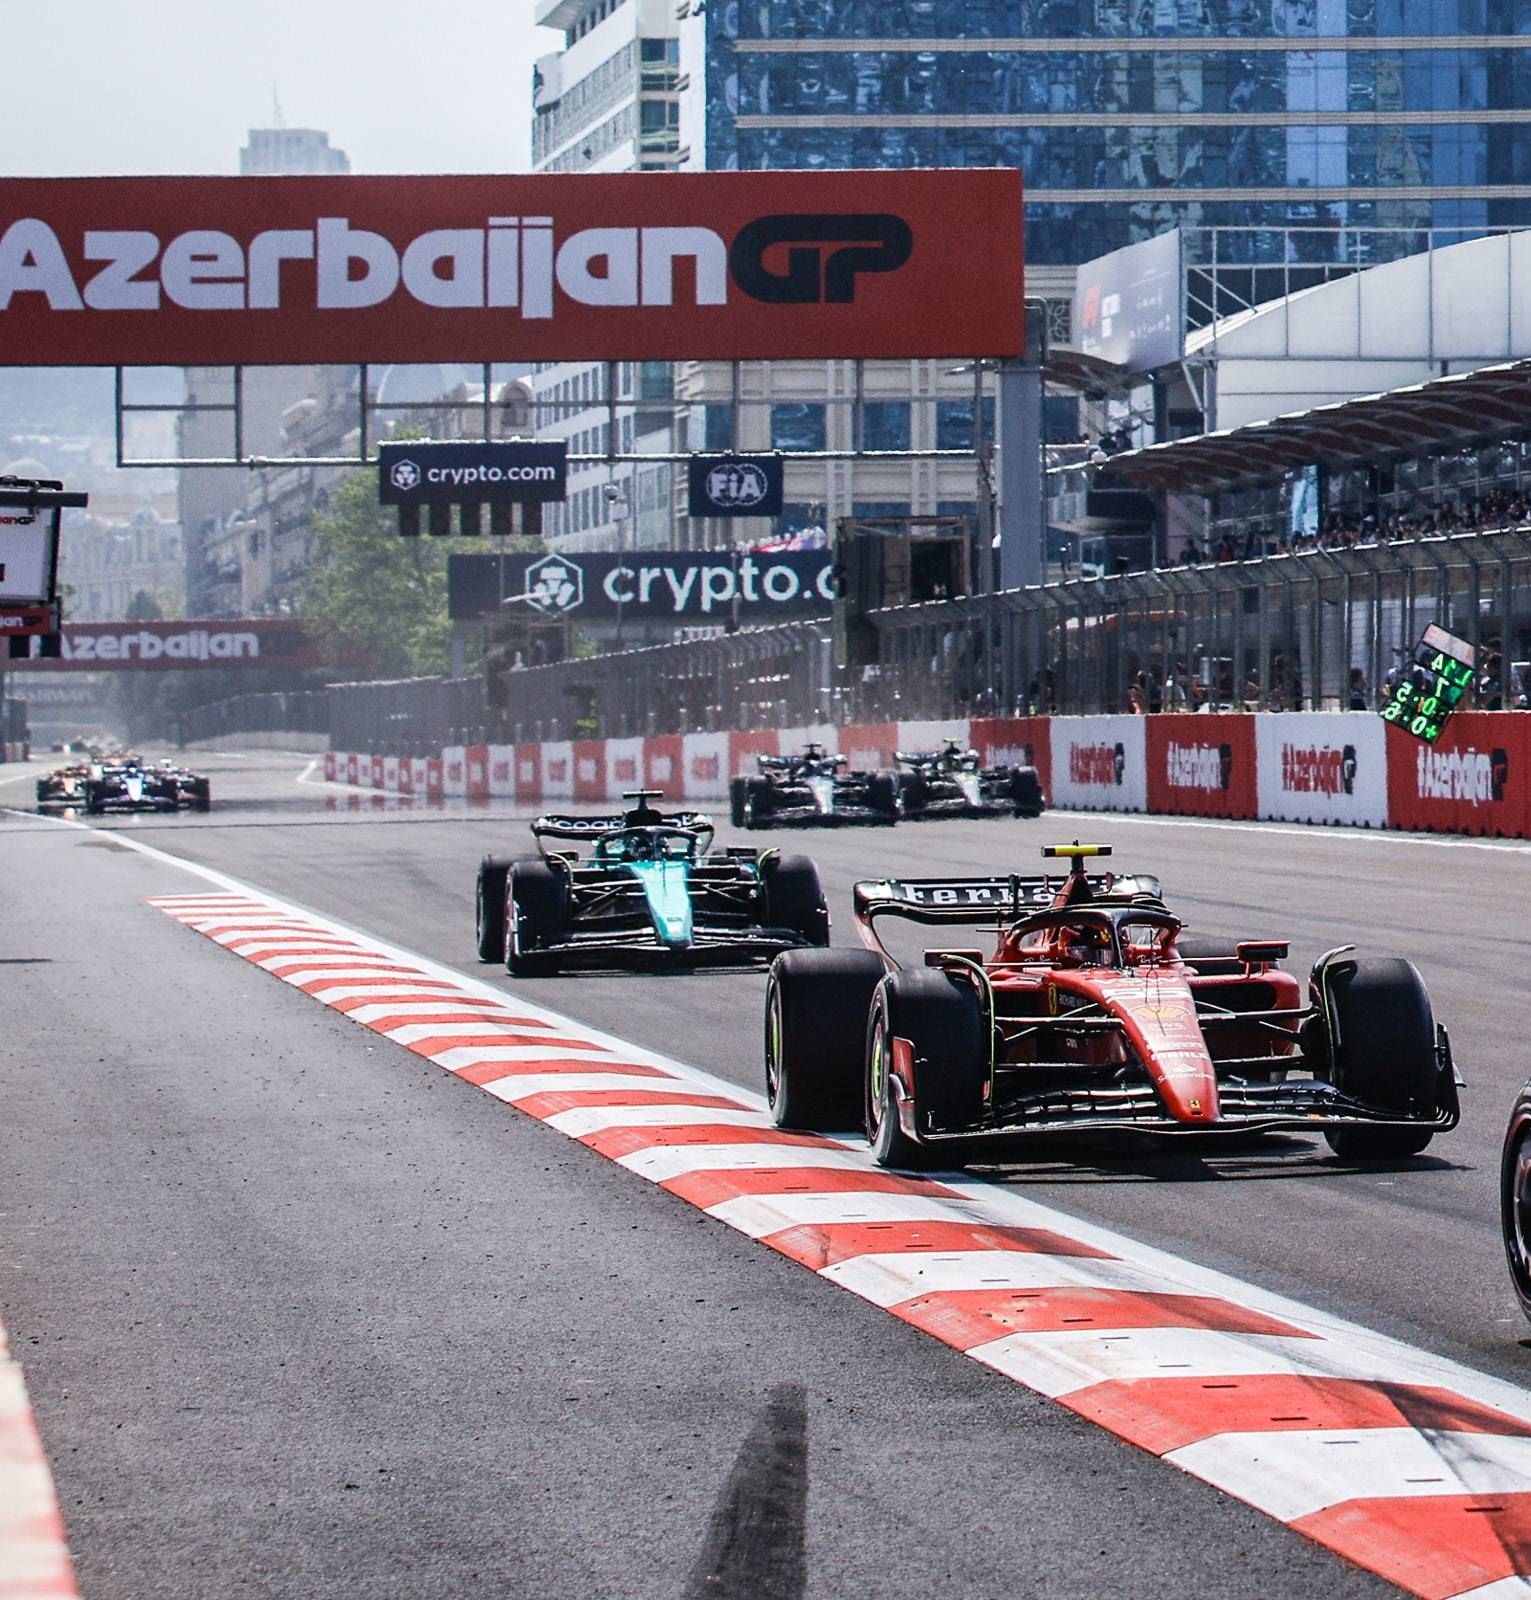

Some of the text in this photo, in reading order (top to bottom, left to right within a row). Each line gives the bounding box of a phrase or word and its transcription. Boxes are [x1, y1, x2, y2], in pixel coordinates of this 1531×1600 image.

[428, 462, 556, 483] crypto.com
[603, 556, 834, 612] crypto.c
[901, 881, 1107, 906] Ferra
[1157, 1072, 1216, 1084] Santander
